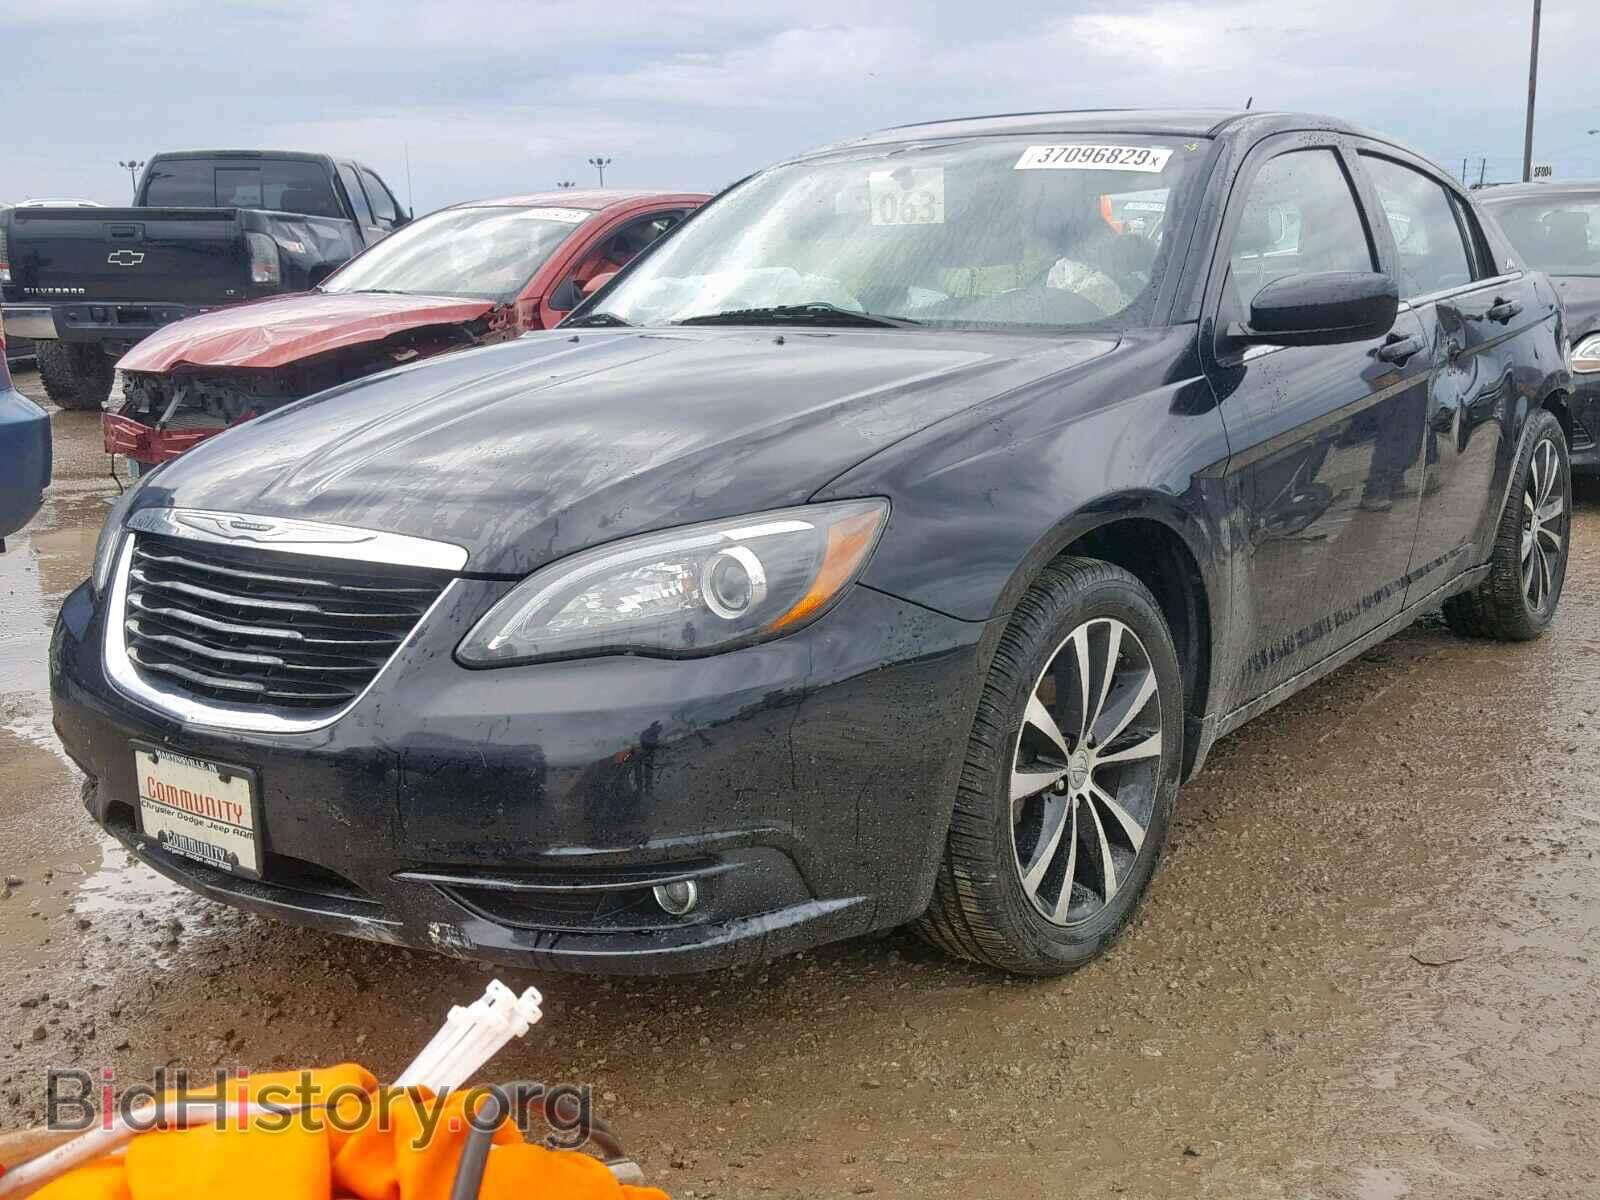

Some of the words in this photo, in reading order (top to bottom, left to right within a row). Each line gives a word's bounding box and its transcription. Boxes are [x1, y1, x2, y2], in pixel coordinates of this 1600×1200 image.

[141, 799, 175, 817] Chrysler
[177, 812, 204, 826] Dodge
[207, 822, 230, 834] Jeep
[147, 776, 242, 824] COMMUNITY
[166, 831, 225, 862] COMMUNITY
